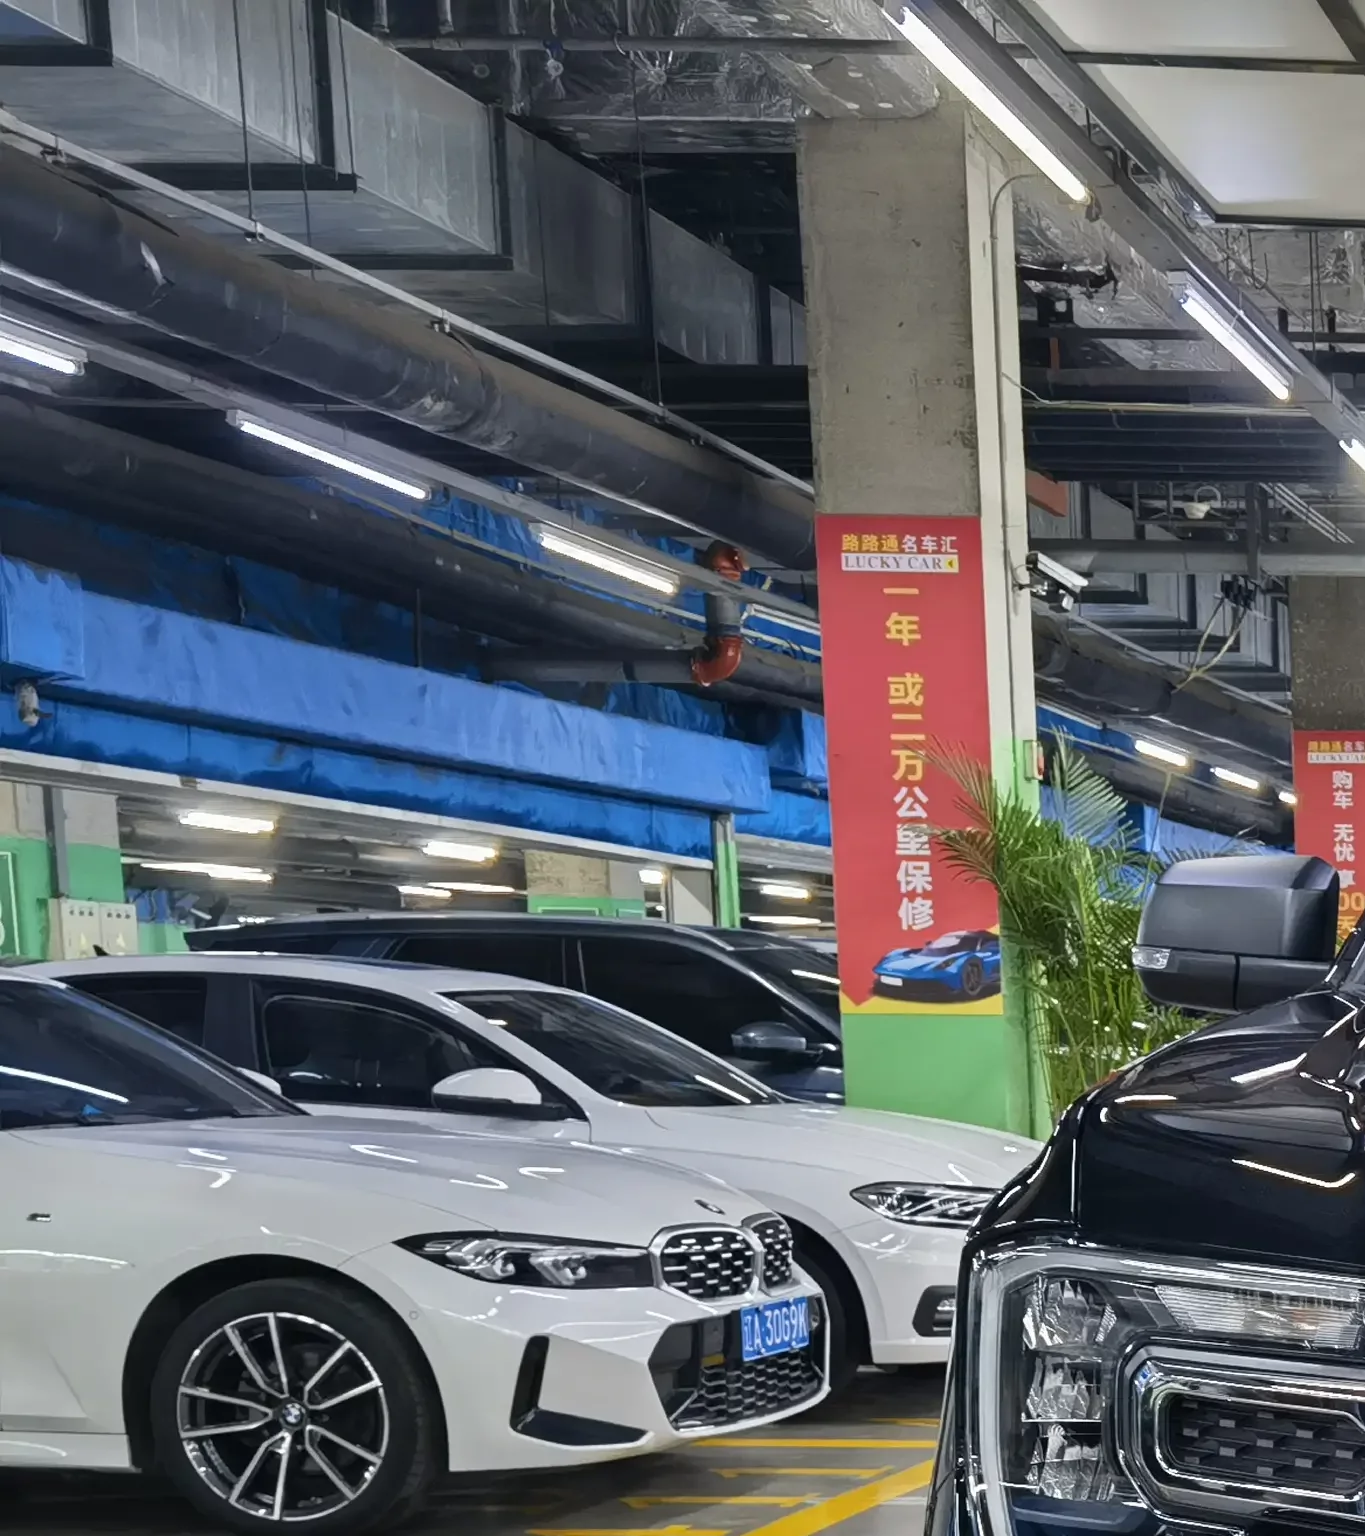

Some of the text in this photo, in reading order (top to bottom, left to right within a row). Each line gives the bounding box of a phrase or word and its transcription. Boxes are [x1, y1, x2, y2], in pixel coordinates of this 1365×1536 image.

[841, 534, 958, 553] 路路通名车汇
[844, 556, 942, 570] LUCKY CAR
[1332, 770, 1354, 810] 购车
[1333, 823, 1355, 862] 无忧
